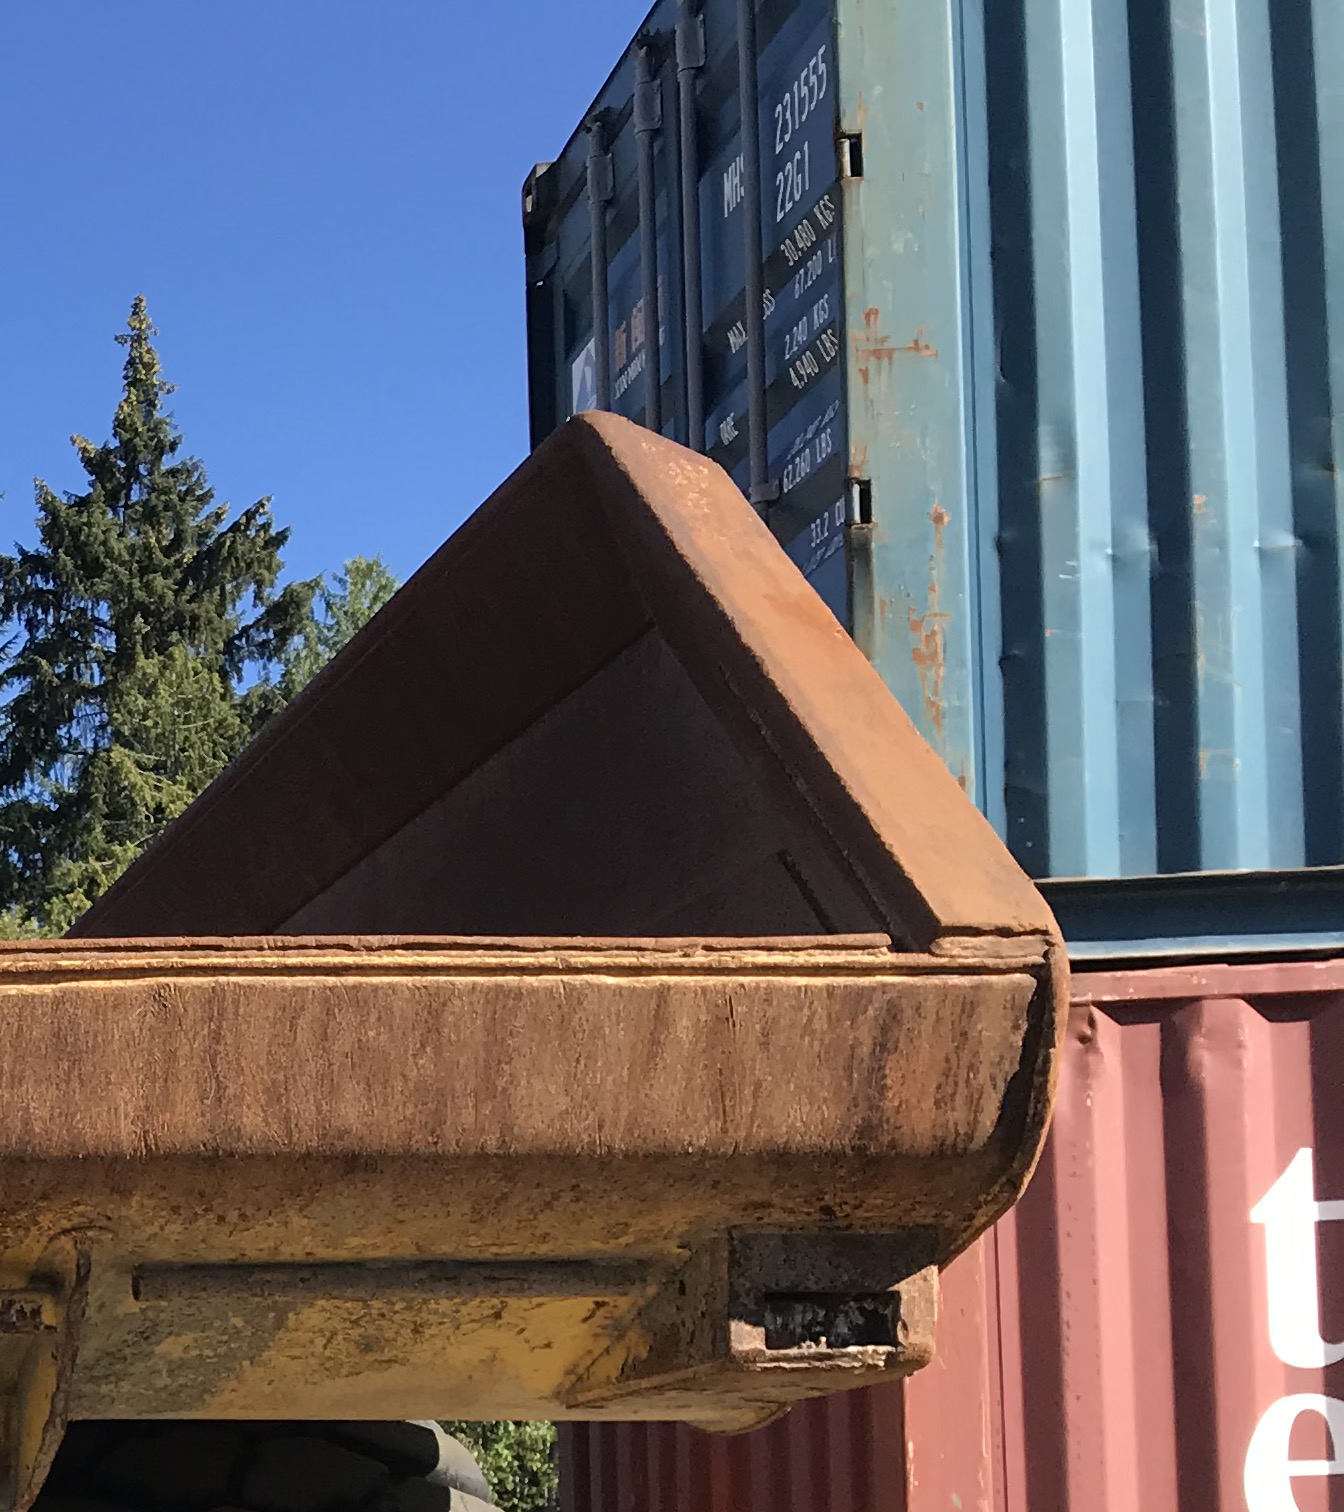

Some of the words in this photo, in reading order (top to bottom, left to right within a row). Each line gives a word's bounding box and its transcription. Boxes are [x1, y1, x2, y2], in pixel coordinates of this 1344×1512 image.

[774, 44, 827, 155] 231555
[775, 140, 810, 222] 22G1
[813, 194, 836, 229] KGS
[813, 293, 830, 331] KGS
[816, 328, 839, 363] LBS
[815, 427, 832, 464] LBS
